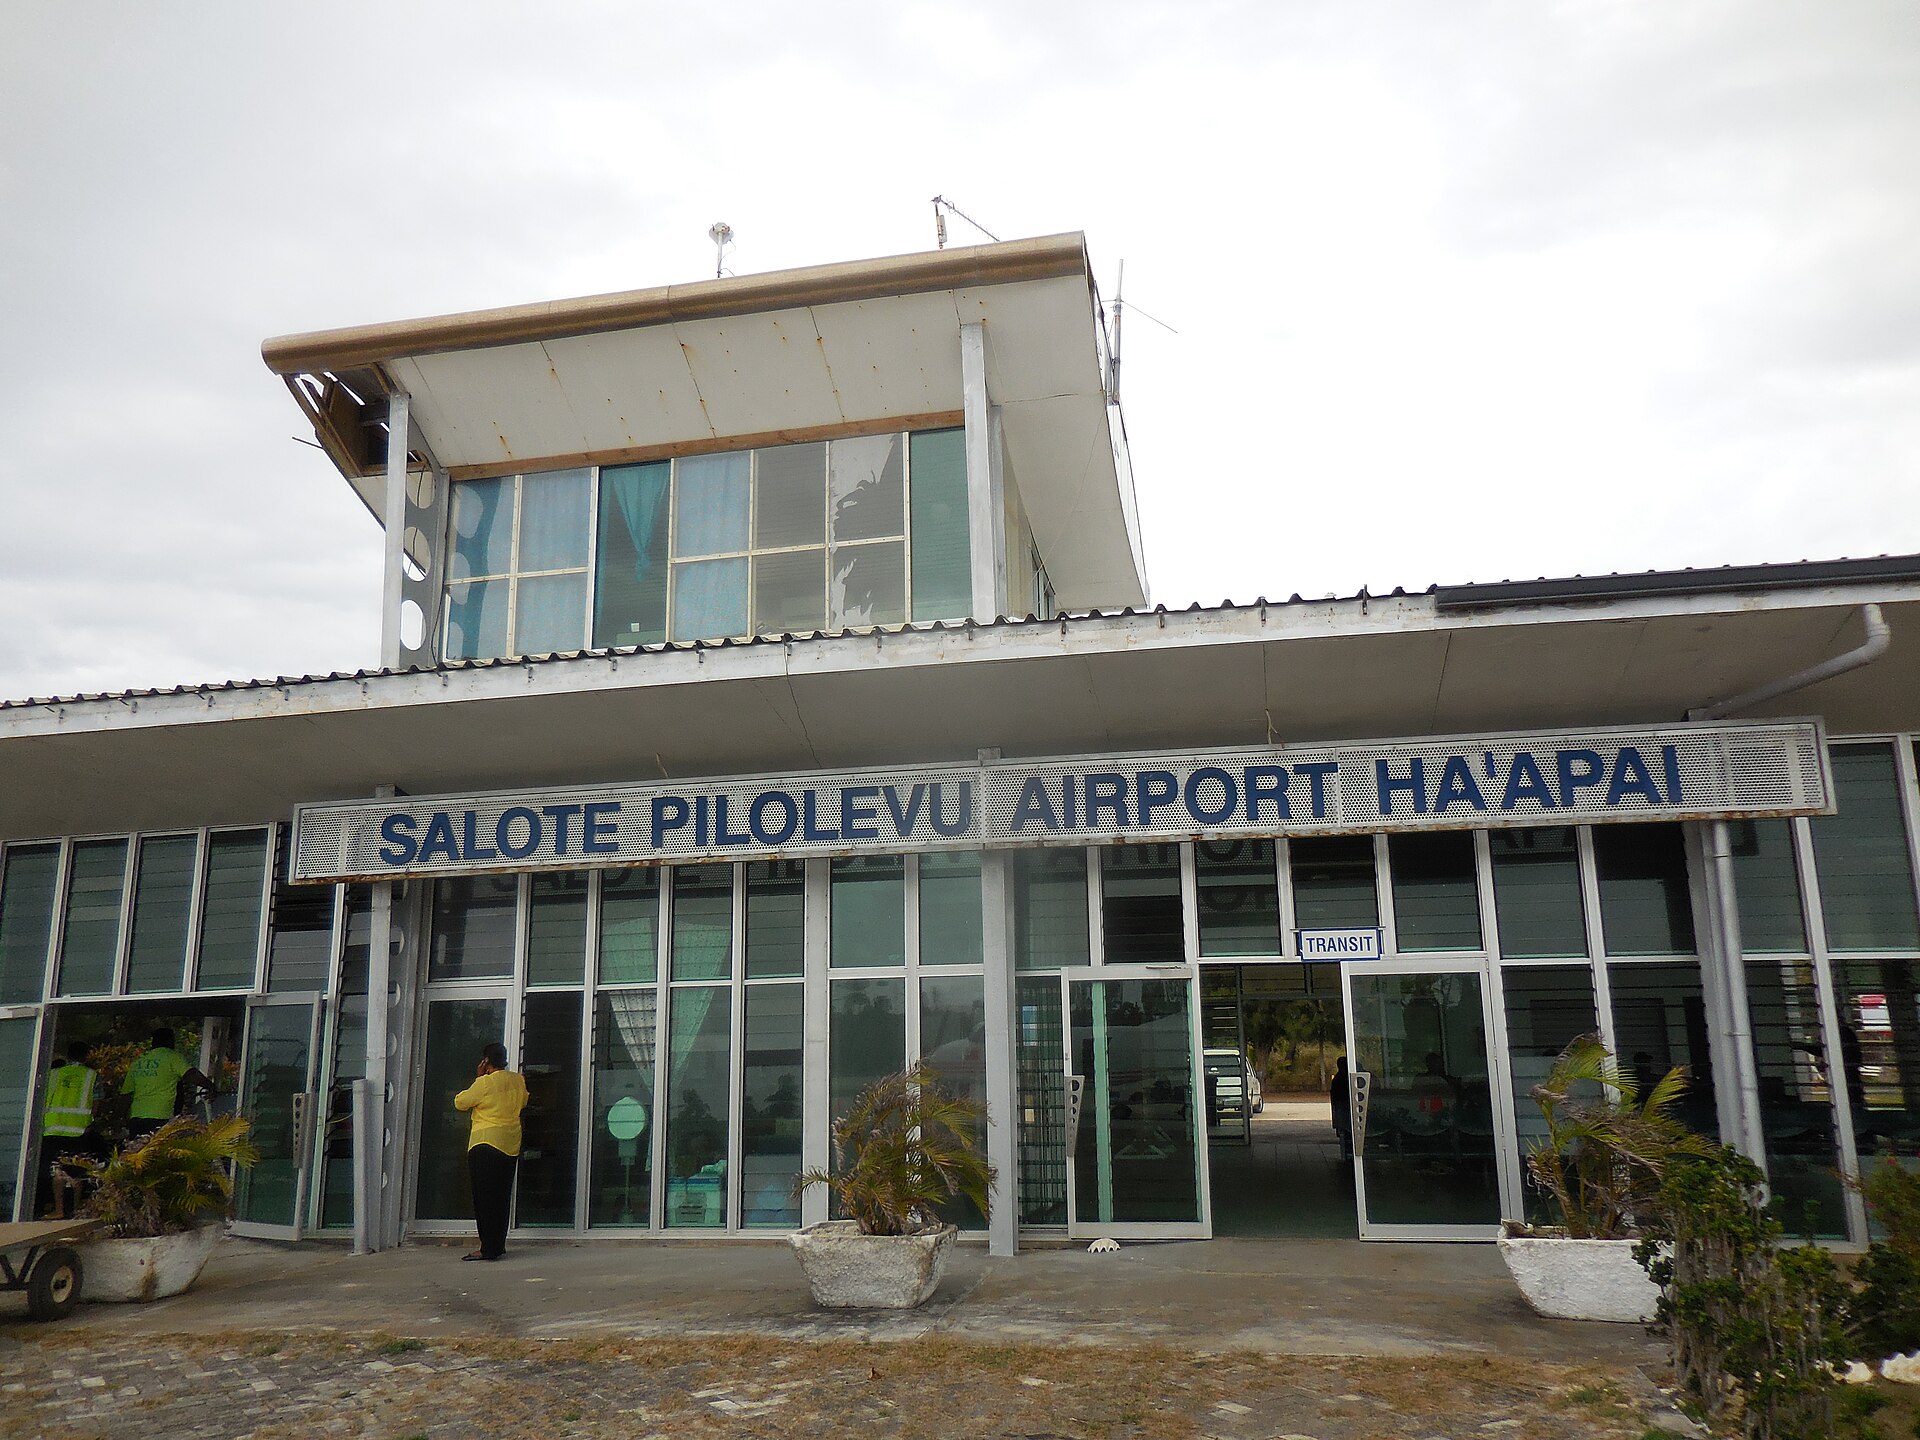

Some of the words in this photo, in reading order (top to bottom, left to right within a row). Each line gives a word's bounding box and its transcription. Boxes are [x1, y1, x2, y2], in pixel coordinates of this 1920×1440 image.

[380, 802, 622, 865] SALOTE
[651, 781, 971, 848] PILOLEVU
[1009, 761, 1338, 832] AIRPORT
[1375, 745, 1684, 815] HA'APAI
[1305, 936, 1373, 953] TRANSIT
